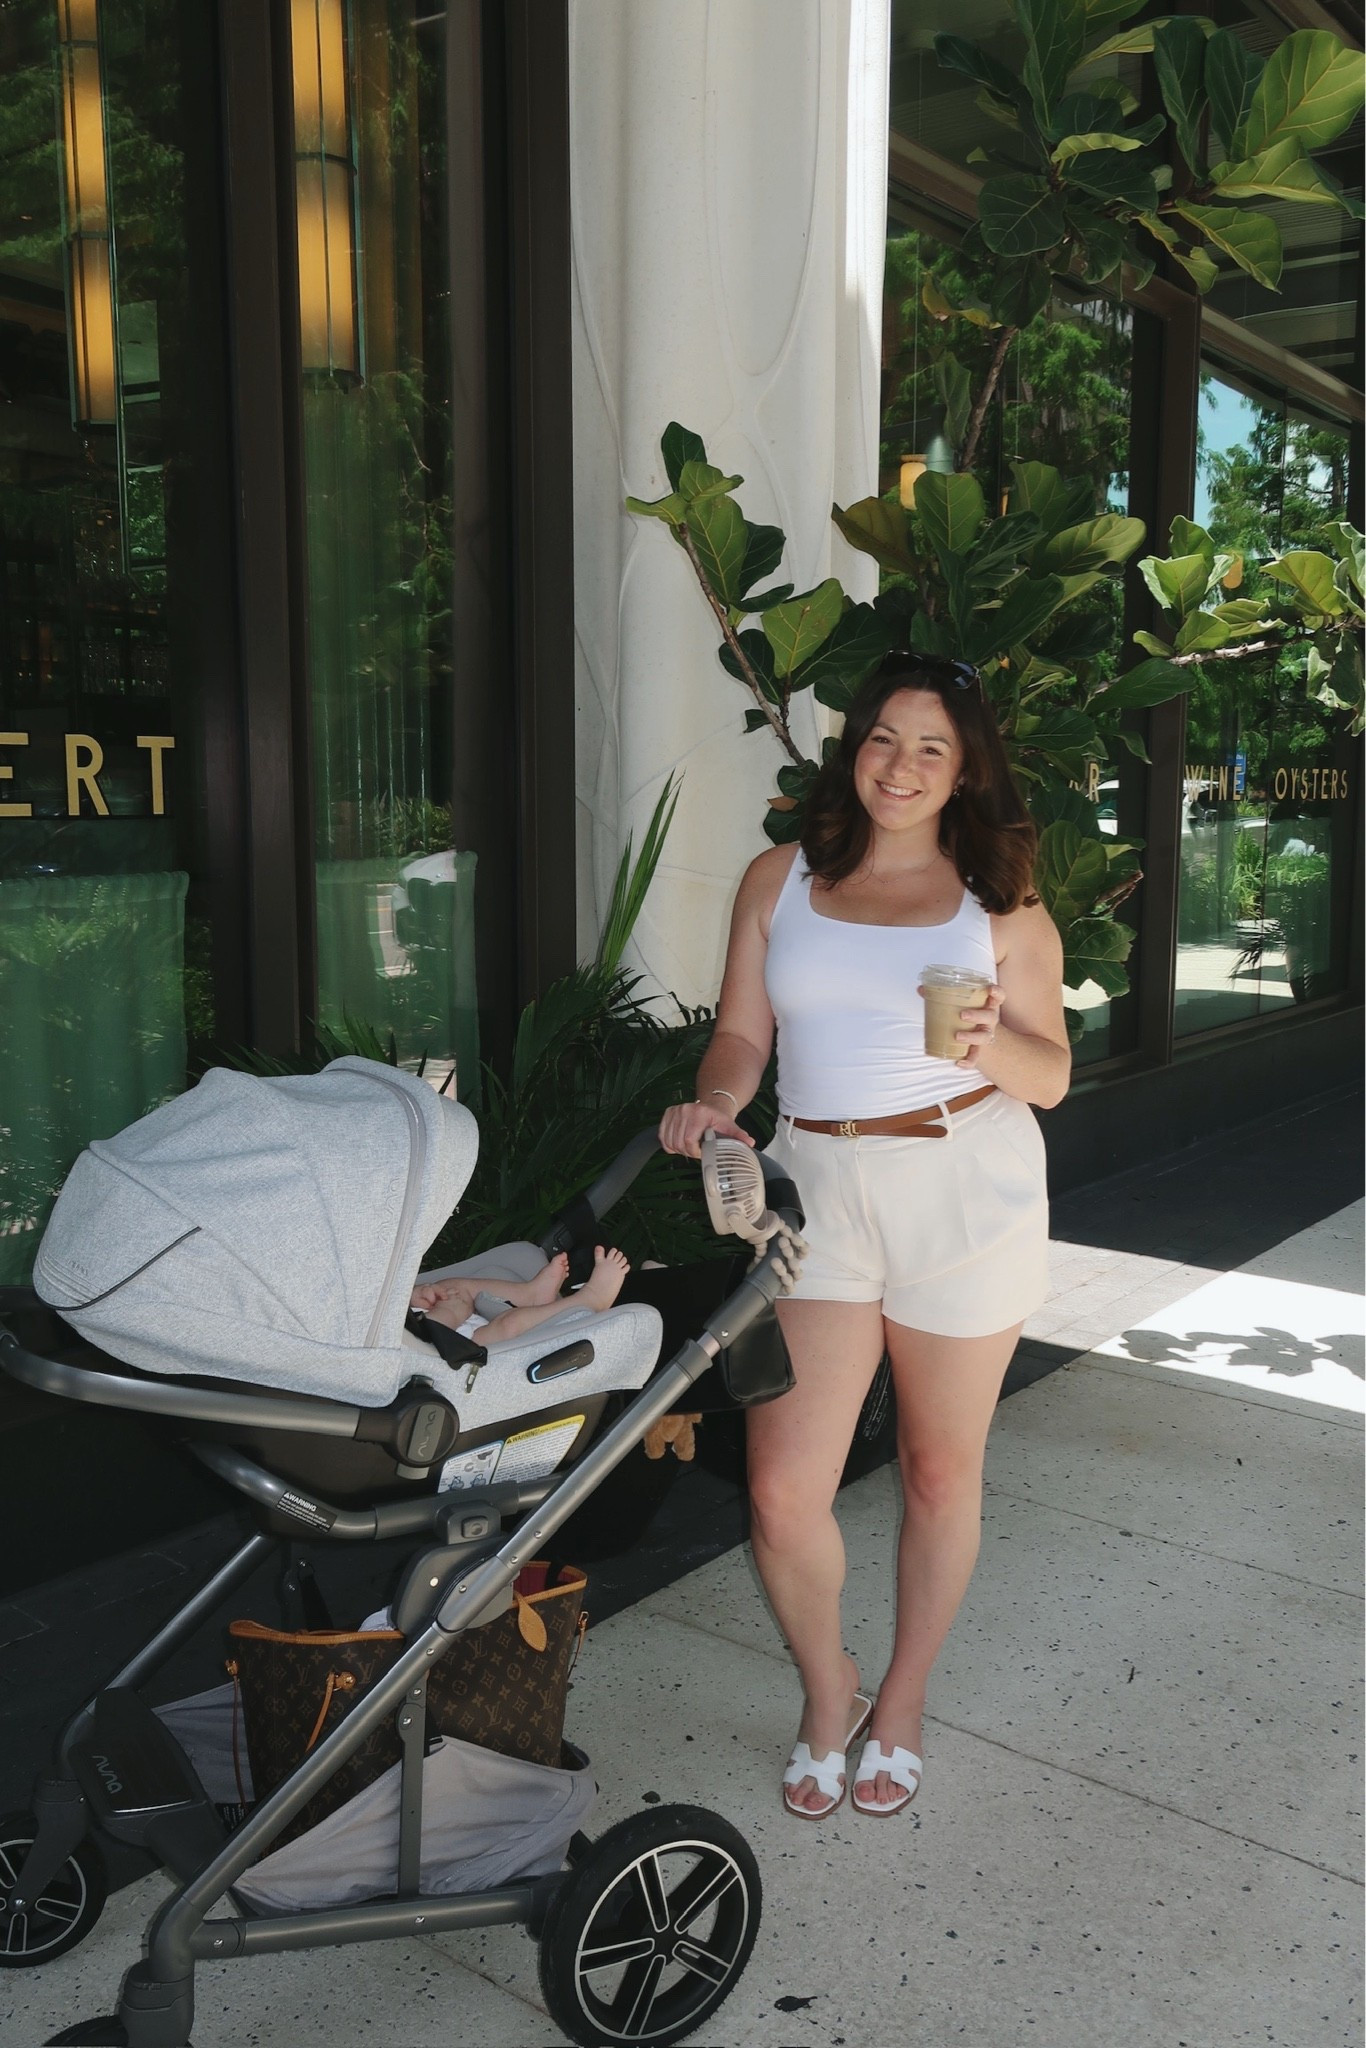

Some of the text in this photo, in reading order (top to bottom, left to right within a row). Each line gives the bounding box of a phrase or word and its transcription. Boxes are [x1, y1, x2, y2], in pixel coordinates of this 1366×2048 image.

[1185, 764, 1349, 802] WINE OYSTERS
[289, 1493, 317, 1512] WARNING
[92, 1755, 123, 1794] nuna
